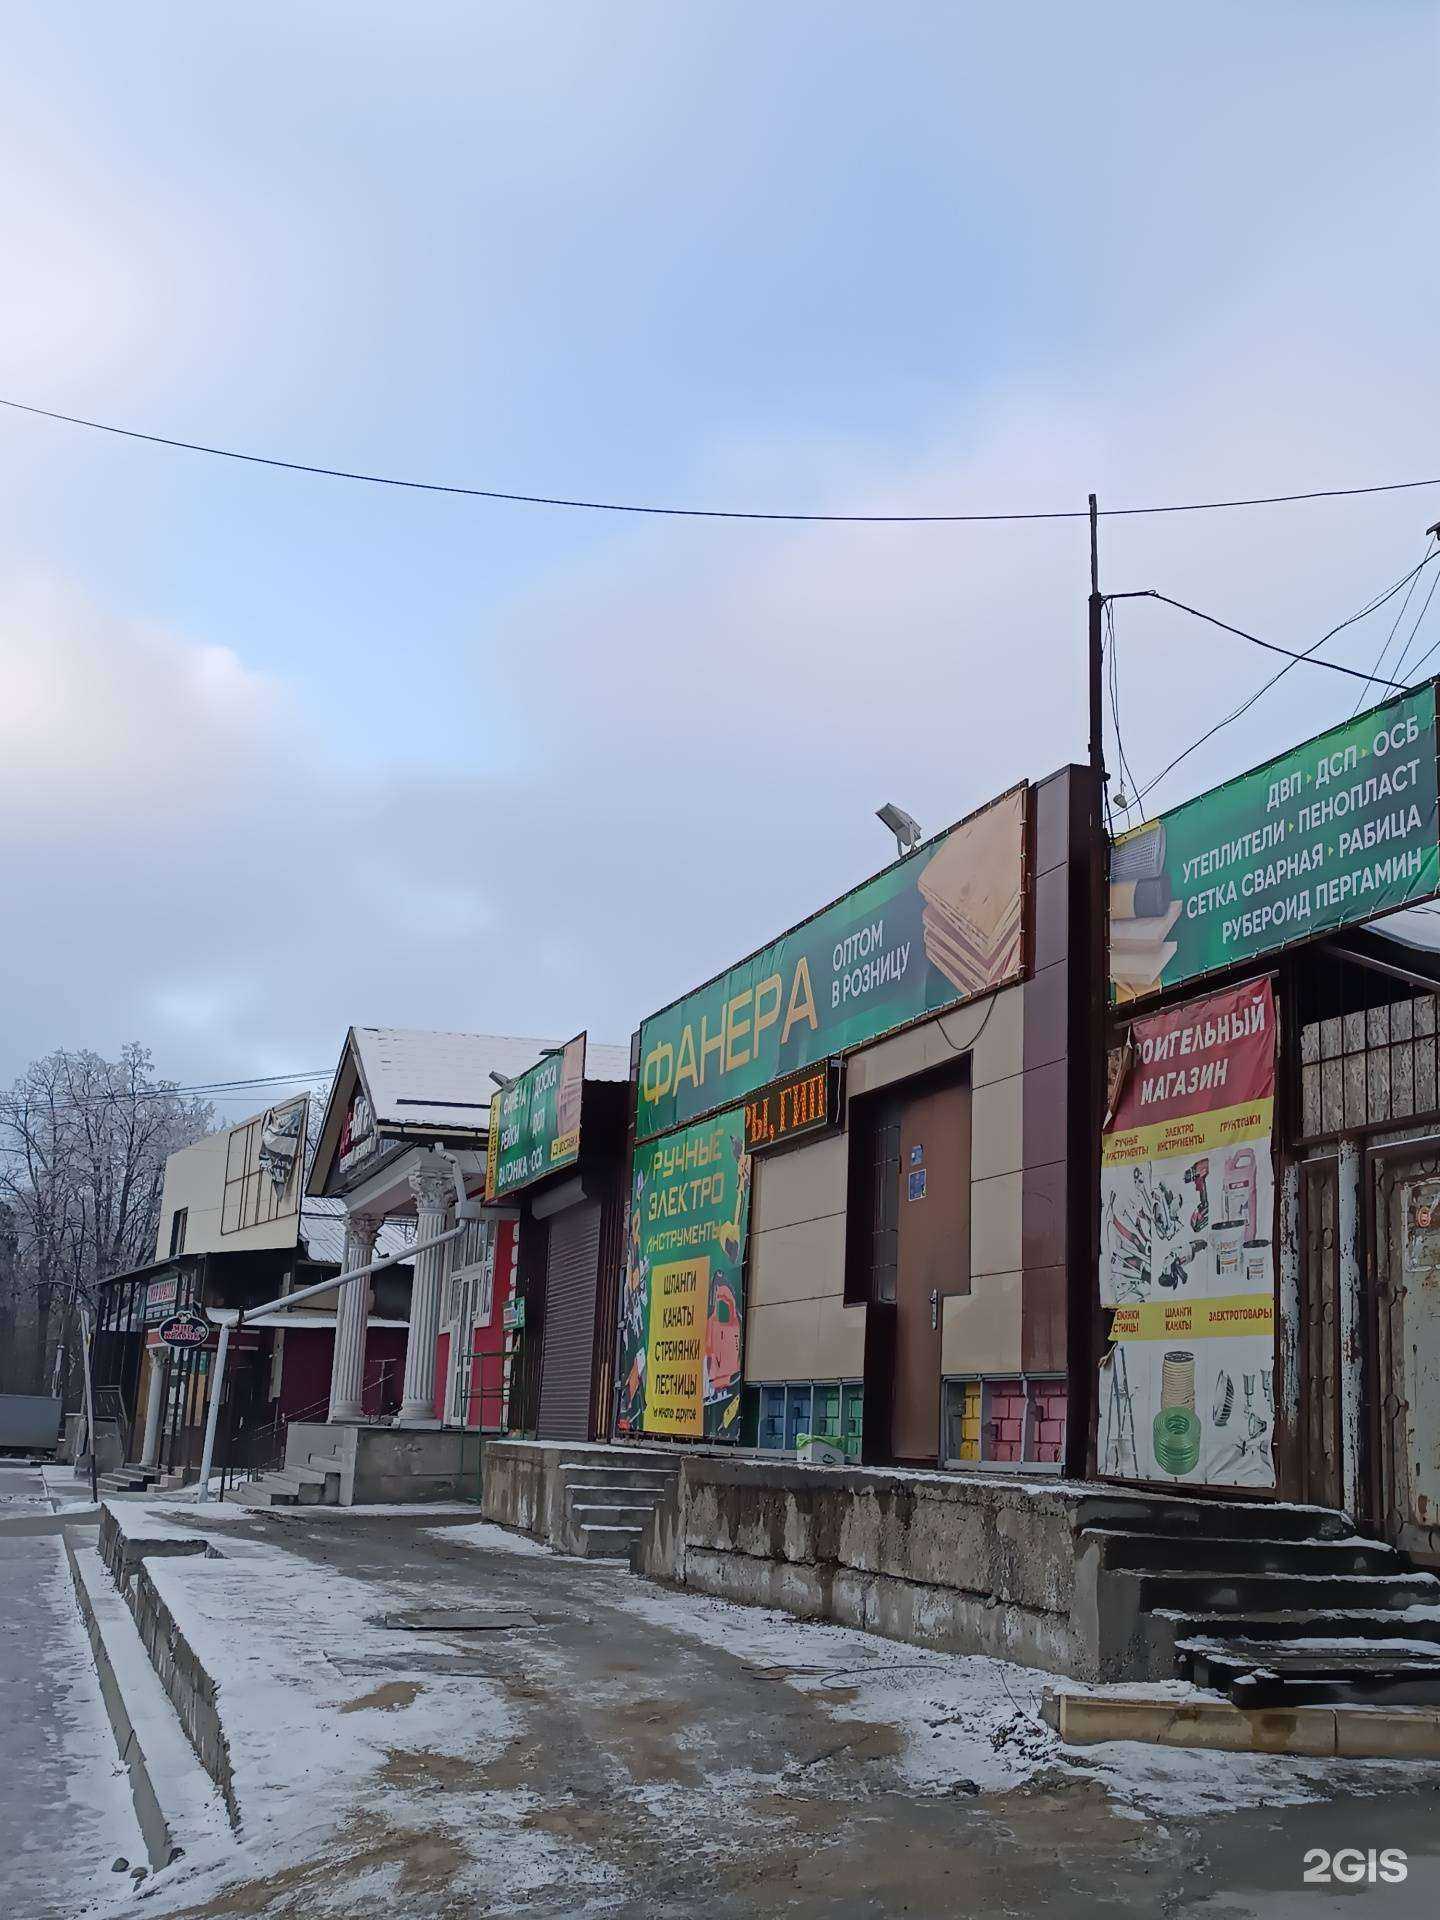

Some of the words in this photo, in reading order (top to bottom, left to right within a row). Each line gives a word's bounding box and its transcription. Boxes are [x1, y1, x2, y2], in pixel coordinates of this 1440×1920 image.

[1267, 772, 1302, 812] ДВП
[1315, 745, 1357, 788] ДСП
[1372, 715, 1419, 757] ОСБ
[1182, 819, 1285, 884] УТЕПЛИТЕЛИ
[1299, 758, 1420, 833] ПЕНОПЛАСТ
[1187, 880, 1237, 919] СЕТКА
[1241, 843, 1323, 897] СВАРНАЯ
[1339, 805, 1422, 858] РАБИЦА
[1222, 890, 1311, 944] РУБЕРОИД
[1315, 848, 1421, 909] ПЕРГАМИН
[832, 920, 884, 973] ОПТОМ
[831, 981, 839, 1008] В
[843, 942, 911, 1003] РОЗНИЦУ
[643, 956, 819, 1104] ФАНЕРА
[1140, 1058, 1228, 1105] МАГАЗИН
[1157, 1134, 1205, 1152] ИНСТРУМЕНТЫ
[1165, 1123, 1194, 1138] ЭЛЕКТРО
[653, 1129, 724, 1180] РУЧНЫЕ
[649, 1173, 724, 1221] ЭЛЕКТРО
[664, 1271, 697, 1295] ШЛАНГИ
[663, 1305, 695, 1328] КАНАТЫ
[1165, 1307, 1192, 1318] ШЛАНГИ
[1166, 1320, 1192, 1331] КАНАТЫ
[1209, 1308, 1272, 1322] ЭЛЕКТРОТОВАРЫ
[655, 1339, 700, 1361] СТРЕМЯНКИ
[655, 1374, 697, 1399] ЛЕСТНИЦЫ
